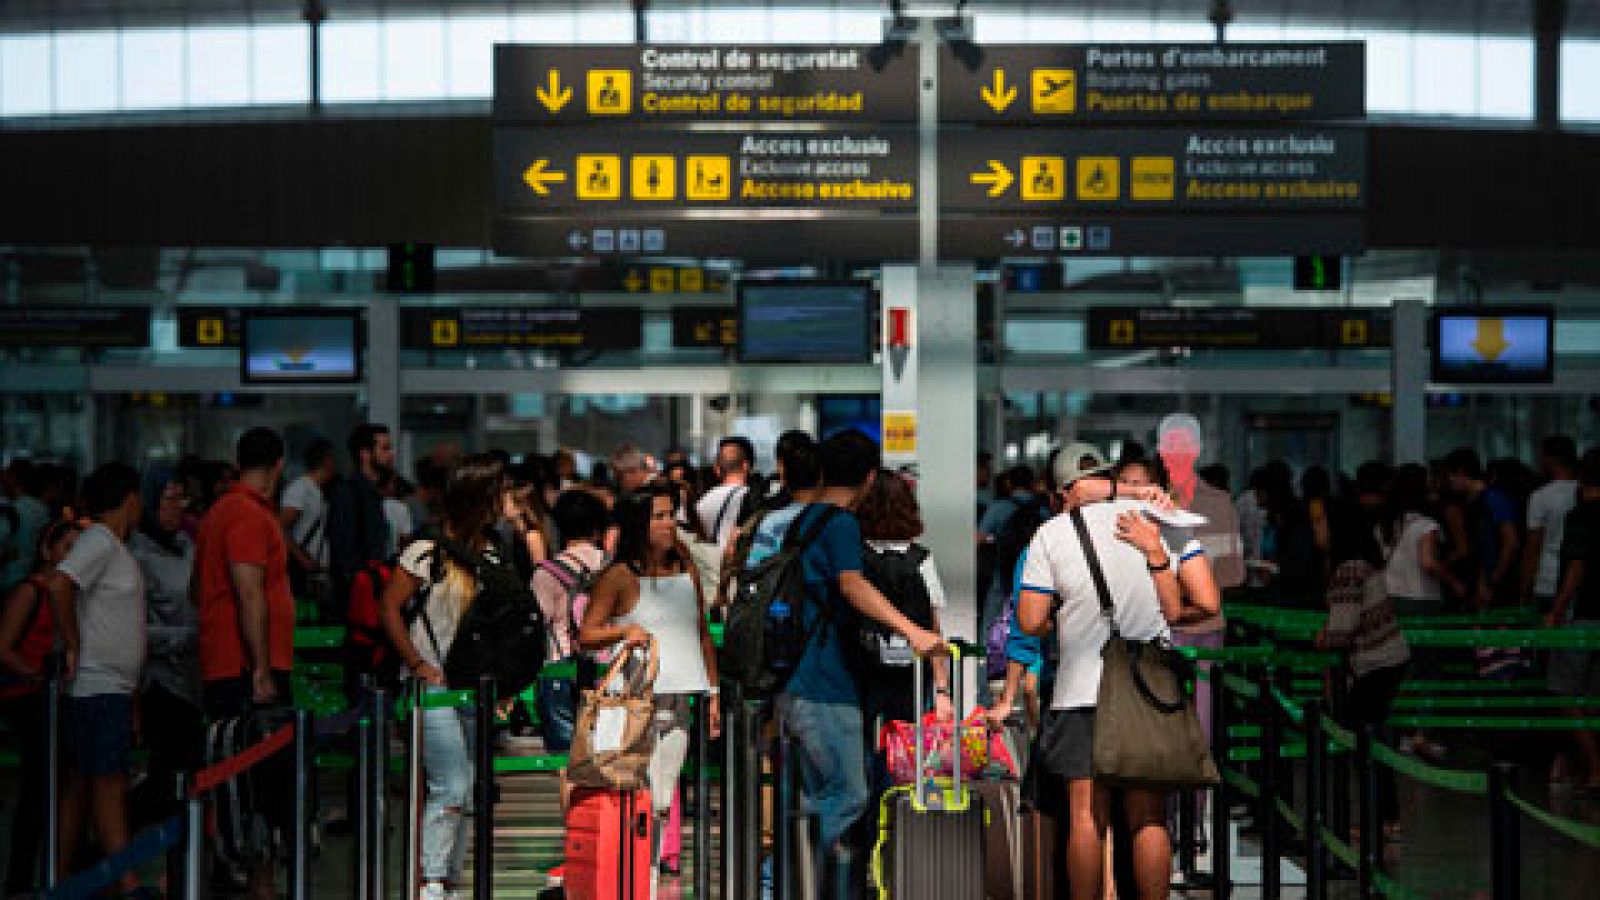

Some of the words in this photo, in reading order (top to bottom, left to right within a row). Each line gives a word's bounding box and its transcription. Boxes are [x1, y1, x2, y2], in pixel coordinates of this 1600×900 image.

[643, 49, 719, 70] Control
[725, 49, 750, 70] de
[758, 49, 860, 72] seguretat
[1086, 48, 1154, 67] Portes
[1162, 47, 1326, 67] d'embarcament
[643, 73, 710, 92] Security
[715, 74, 774, 88] control
[643, 92, 719, 112] Control
[725, 92, 750, 112] de
[759, 92, 863, 115] seguridad
[1086, 92, 1167, 111] Puertas
[1174, 92, 1200, 111] de
[1208, 91, 1312, 112] embarque
[807, 135, 890, 155] exclusiu
[742, 178, 815, 198] Acceso
[819, 177, 912, 198] exclusivo
[1186, 178, 1260, 198] Acceso
[1265, 177, 1360, 198] exclusivo
